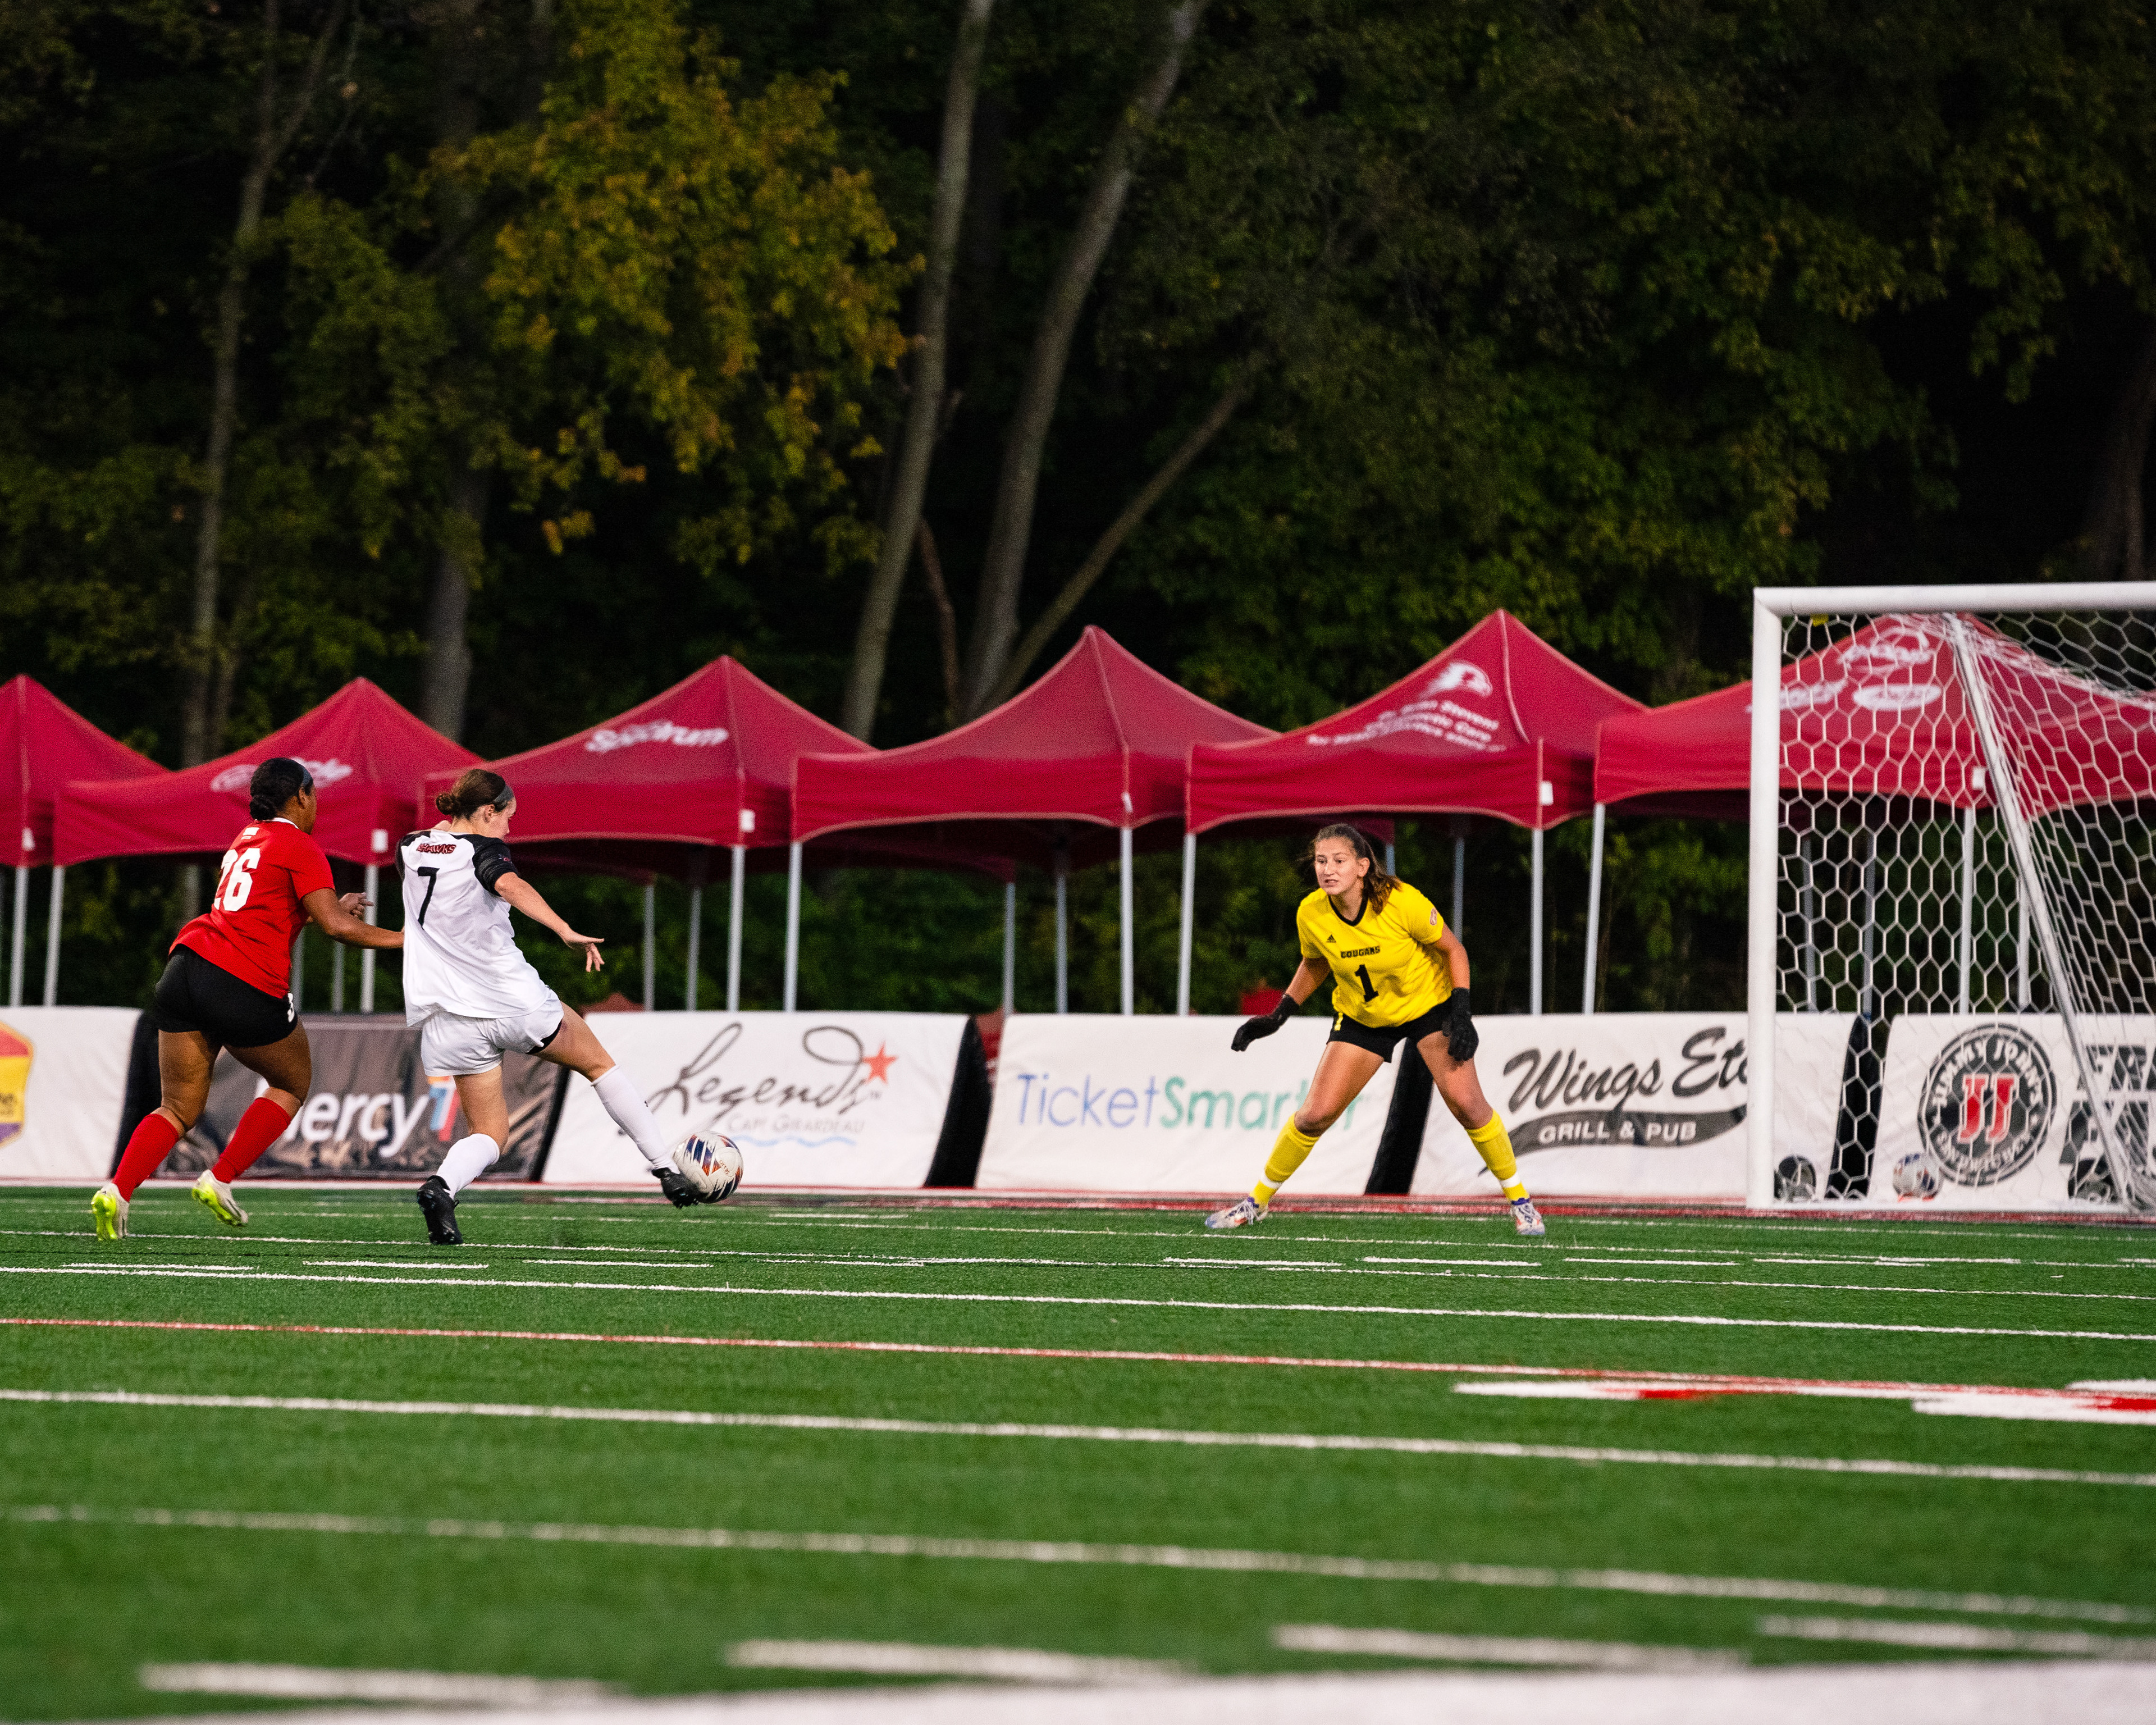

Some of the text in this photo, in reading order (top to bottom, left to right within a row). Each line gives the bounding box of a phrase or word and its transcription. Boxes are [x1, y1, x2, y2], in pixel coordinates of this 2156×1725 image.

[214, 848, 261, 911] 26
[417, 866, 440, 928] 7
[1340, 945, 1381, 959] COUGARS
[1355, 964, 1379, 1002] 1
[646, 1021, 870, 1130] Legends
[1017, 1074, 1364, 1130] TicketSmartr
[1503, 1047, 1663, 1125] Wings
[1538, 1120, 1697, 1144] GRILL & PUB
